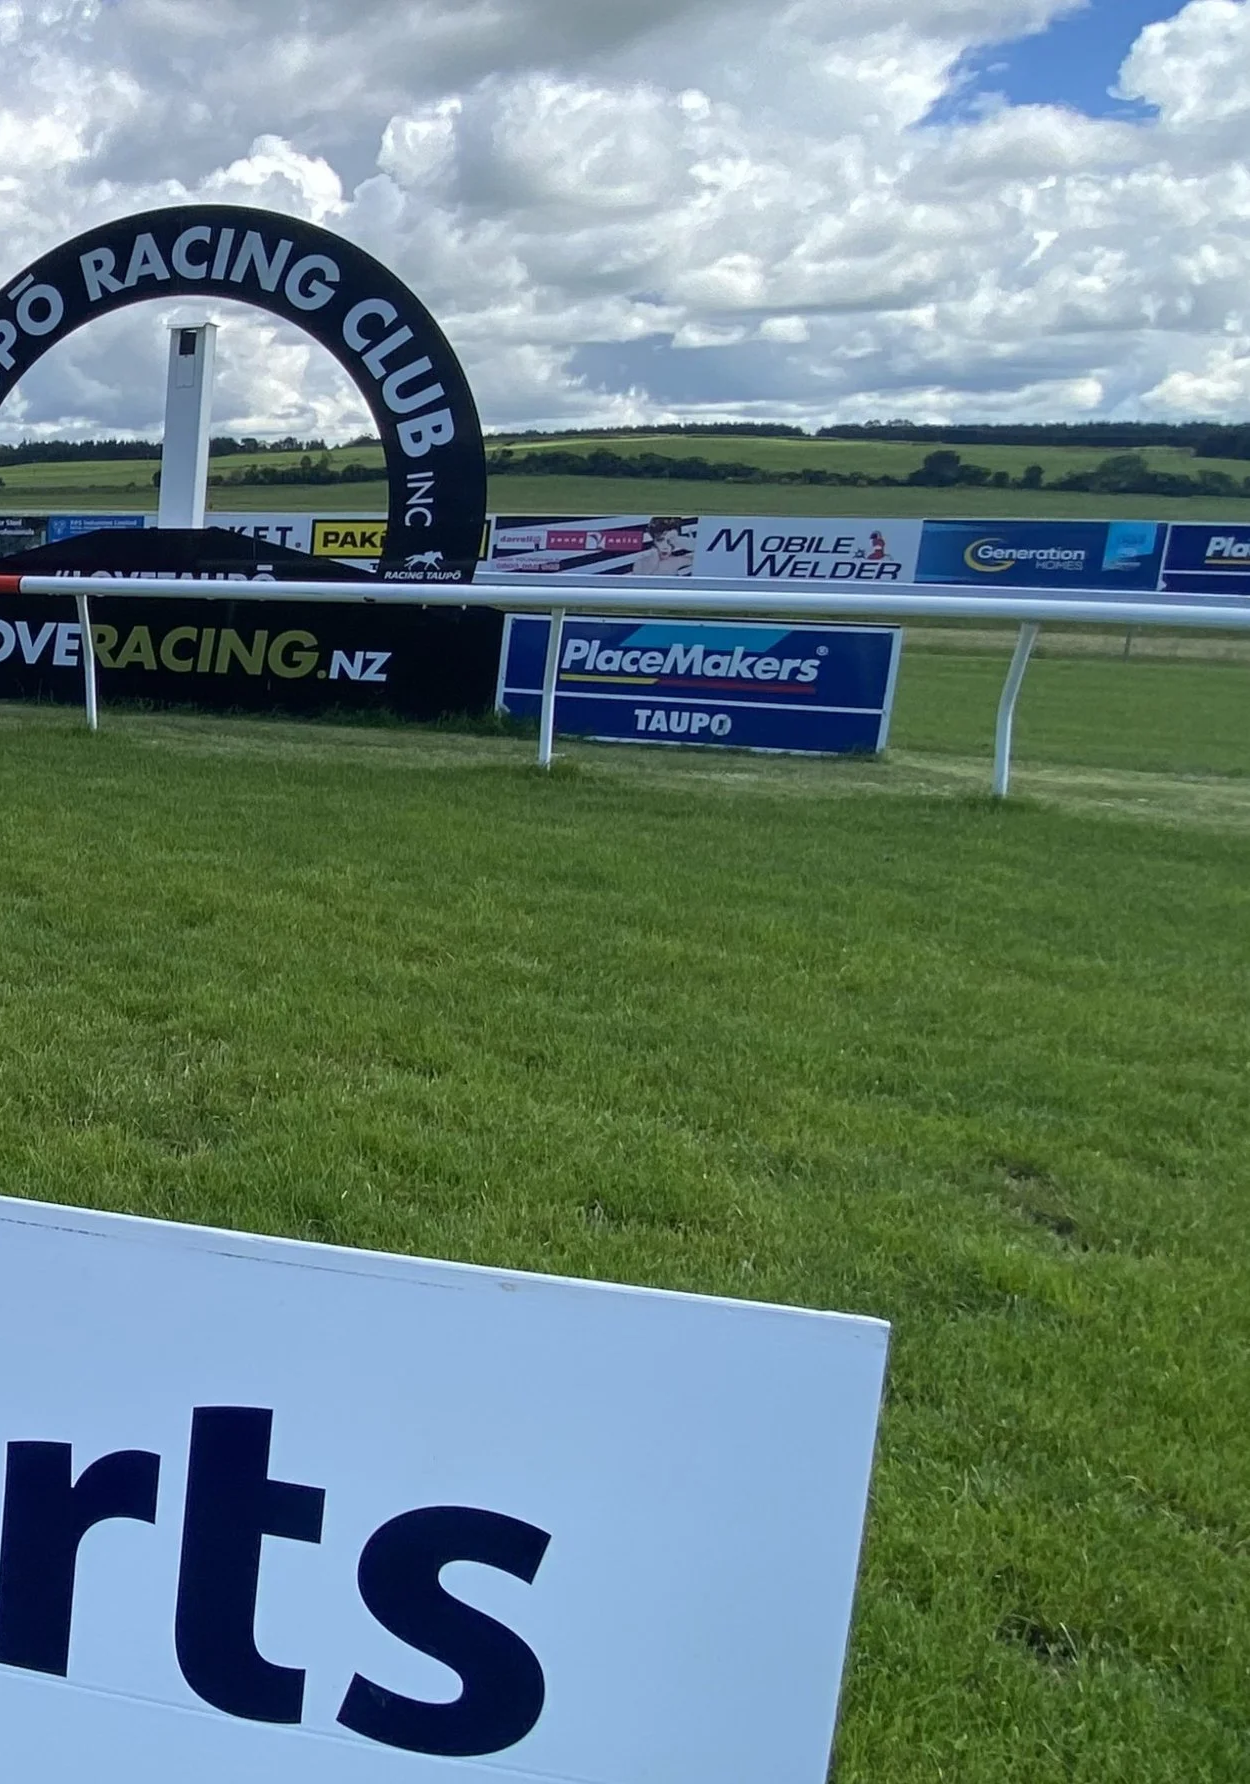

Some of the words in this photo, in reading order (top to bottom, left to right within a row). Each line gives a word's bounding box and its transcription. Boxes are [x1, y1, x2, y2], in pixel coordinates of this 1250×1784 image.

[79, 225, 341, 311] RACING
[342, 298, 455, 458] CLUB
[405, 470, 434, 528] INC
[706, 528, 855, 554] MOBILE
[977, 544, 1086, 561] Generation
[1205, 536, 1250, 558] Pla
[384, 571, 424, 580] RACING
[749, 554, 902, 580] WELDER
[1035, 560, 1084, 571] HOMES
[634, 708, 732, 736] TAUPO
